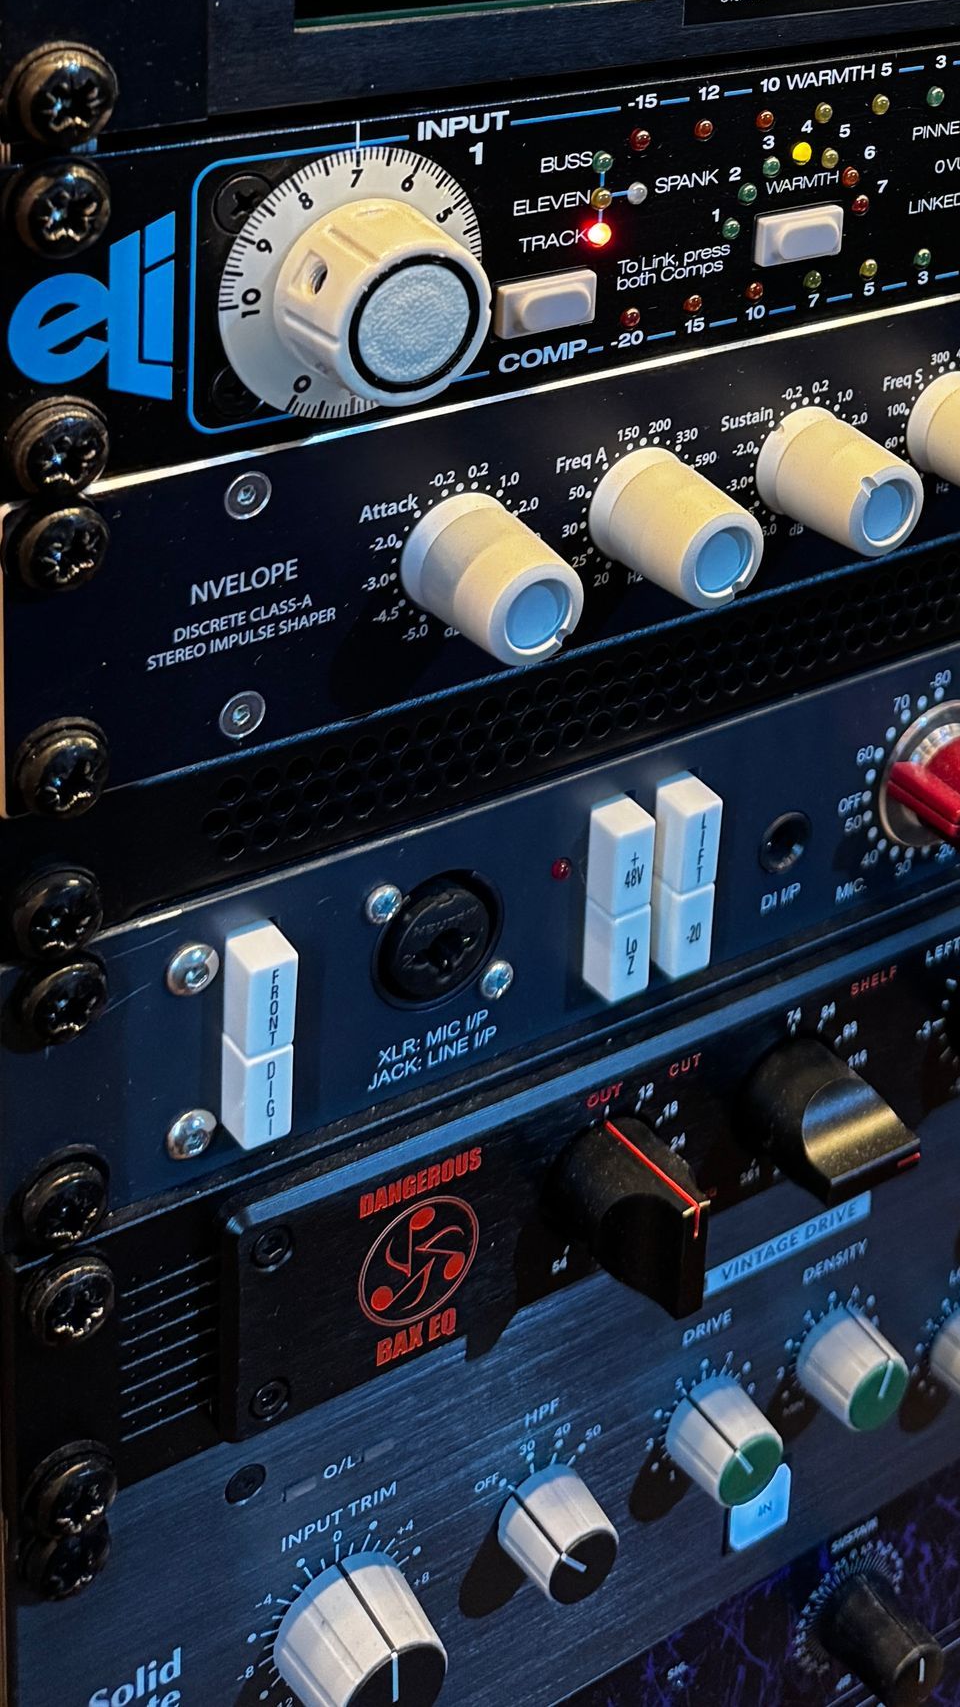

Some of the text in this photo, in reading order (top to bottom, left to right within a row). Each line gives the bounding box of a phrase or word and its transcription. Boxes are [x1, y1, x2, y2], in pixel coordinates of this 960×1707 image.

[628, 64, 875, 110] -15 12 10 WARMTH
[418, 111, 509, 142] INPUT
[468, 143, 483, 165] 1
[541, 152, 593, 174] BUSS
[655, 169, 719, 194] SPANK
[766, 171, 839, 195] WARMTH
[513, 190, 591, 216] ELEVEN
[519, 228, 588, 253] TRACK
[618, 244, 731, 276] To Link, press
[616, 260, 724, 292] both Comps
[611, 305, 766, 349] -20 10
[498, 340, 587, 374] COMP
[930, 351, 950, 365] 300
[883, 369, 923, 392] Freq S
[618, 426, 639, 442] 150
[649, 418, 672, 435] 200
[721, 407, 773, 432] Sustain
[468, 463, 488, 479] 0.2
[555, 447, 607, 473] Freq A
[695, 452, 717, 467] 590
[429, 470, 455, 487] -0.2
[500, 472, 520, 488] 1.0
[359, 494, 418, 524] Attack
[369, 534, 396, 552] -2.0
[190, 559, 299, 605] NVELOPE
[174, 594, 313, 643] DISCRETE CLASS-A
[146, 607, 336, 672] STEREO IMPULSE SHAPER
[839, 793, 862, 813] OFF
[851, 965, 898, 997] SHELF
[270, 968, 279, 1048] FRONT
[378, 1009, 489, 1066] XLR: MIC I/P
[368, 1025, 497, 1092] JACK: LINE I/P
[669, 1053, 701, 1078] CUT
[265, 1059, 276, 1136] DIGI
[586, 1082, 623, 1109] OUT
[359, 1147, 482, 1218] DANGEROUS
[721, 1202, 858, 1281] VINTAGE DRIVE
[803, 1239, 869, 1285] DENSITY
[377, 1308, 457, 1366] BAX EQ
[682, 1309, 734, 1348] DRIVE
[524, 1398, 559, 1428] HPF
[324, 1457, 356, 1478] O/L
[475, 1472, 499, 1492] OFF
[280, 1482, 398, 1552] INPUT TRIM
[89, 1647, 181, 1707] Solid
